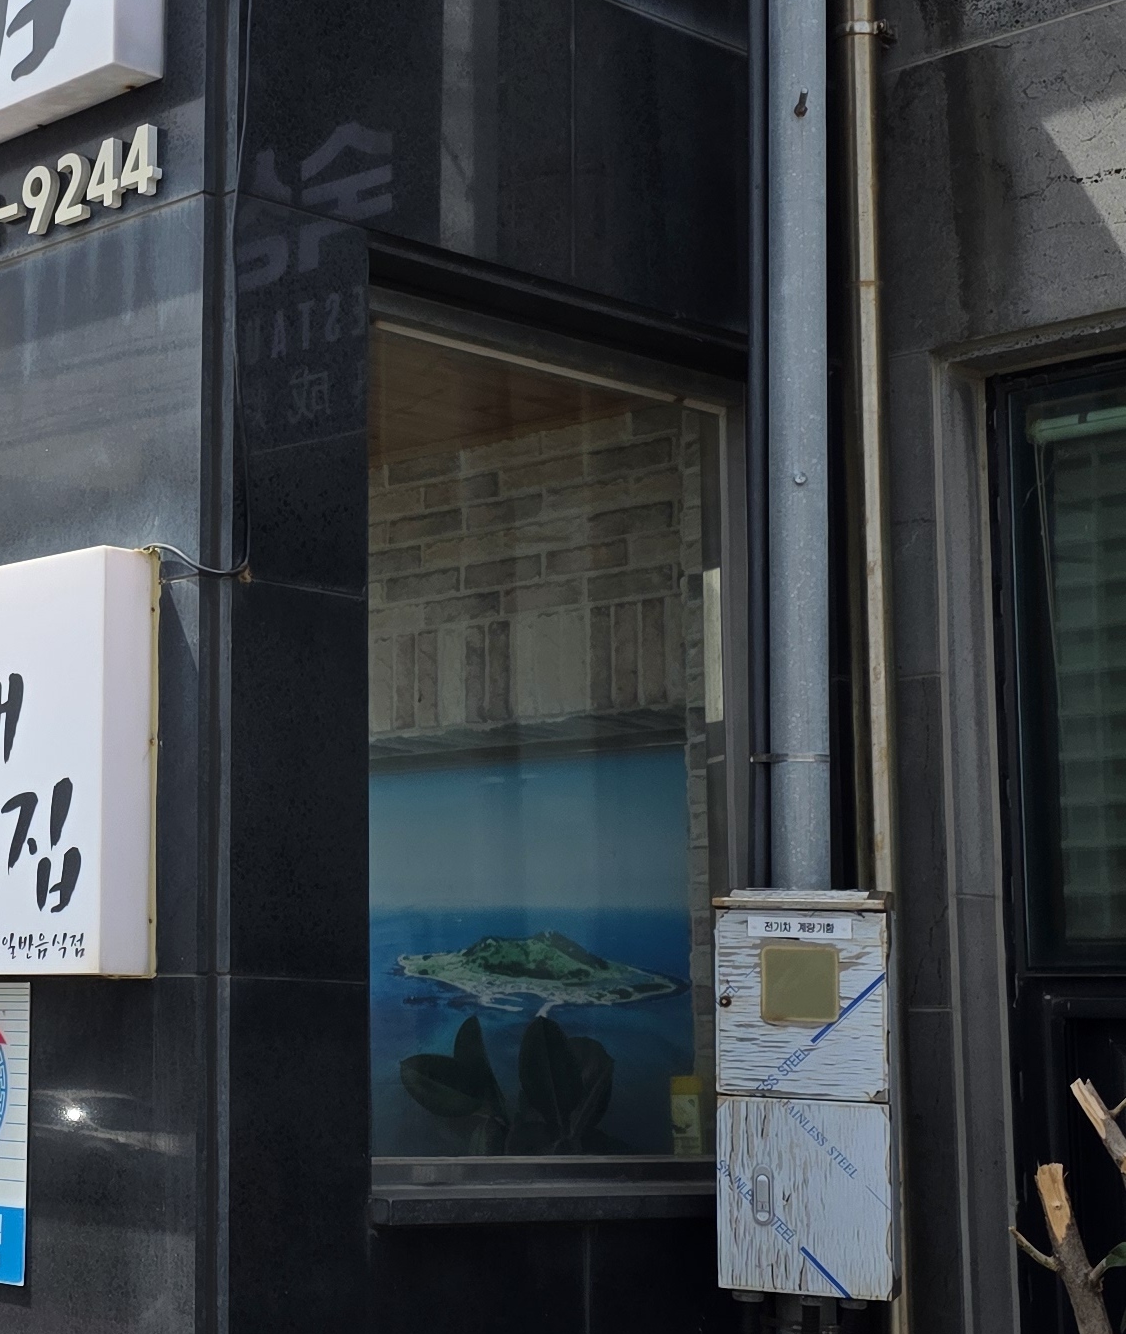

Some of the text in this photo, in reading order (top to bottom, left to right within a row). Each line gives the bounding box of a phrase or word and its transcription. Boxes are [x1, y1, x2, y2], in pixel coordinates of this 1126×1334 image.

[764, 921, 791, 933] 전기차
[1, 932, 85, 960] 일반음식점
[777, 1048, 811, 1078] STEEL
[827, 1145, 858, 1180] STEEL
